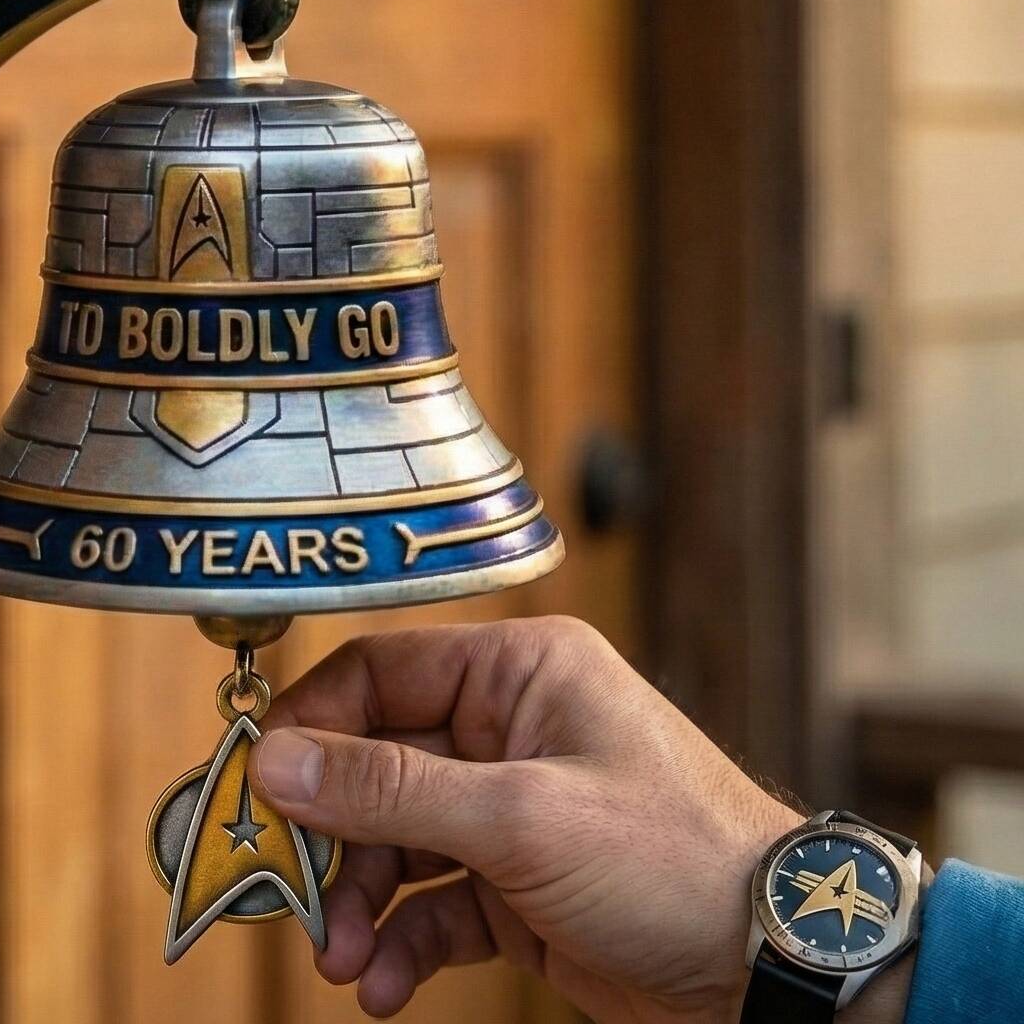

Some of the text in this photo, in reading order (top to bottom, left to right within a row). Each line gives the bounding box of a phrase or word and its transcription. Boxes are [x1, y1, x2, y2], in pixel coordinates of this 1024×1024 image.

[119, 306, 318, 363] BOLDLY
[338, 300, 400, 359] GO
[69, 524, 371, 575] 60 YEARS
